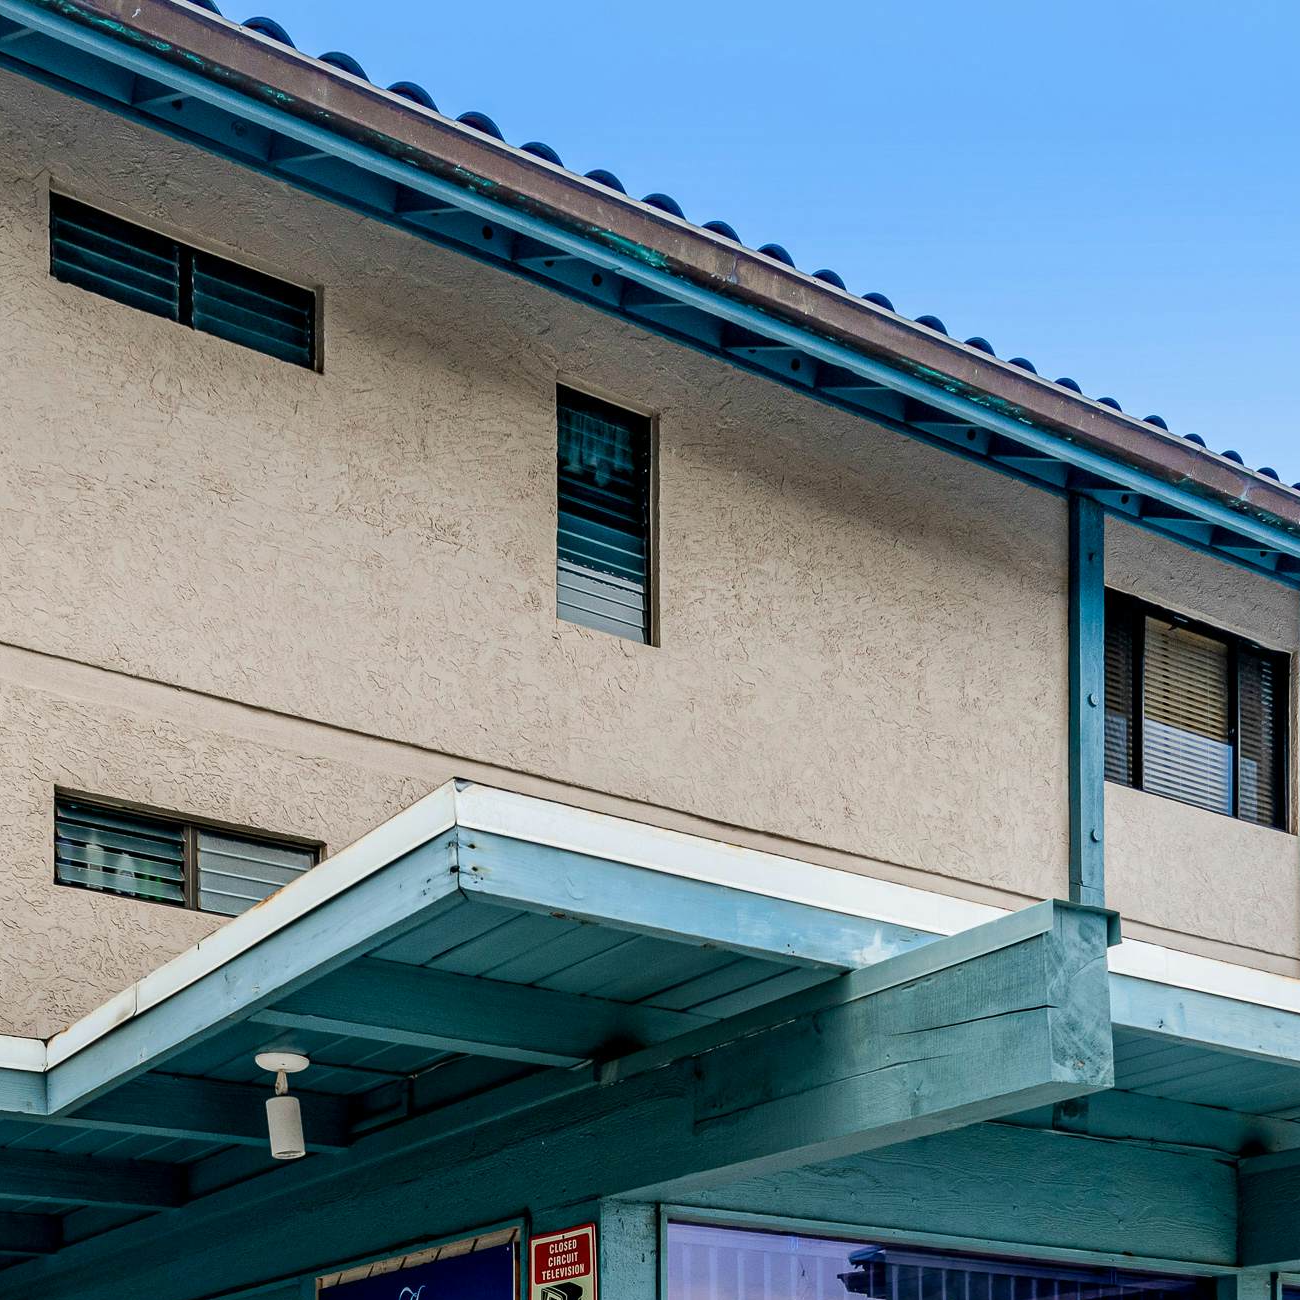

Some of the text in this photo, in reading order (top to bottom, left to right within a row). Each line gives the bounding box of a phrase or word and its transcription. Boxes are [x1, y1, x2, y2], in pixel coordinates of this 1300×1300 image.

[549, 1239, 577, 1254] CLOSED
[548, 1252, 578, 1267] CIRCUIT
[542, 1264, 585, 1280] TELEVISION
